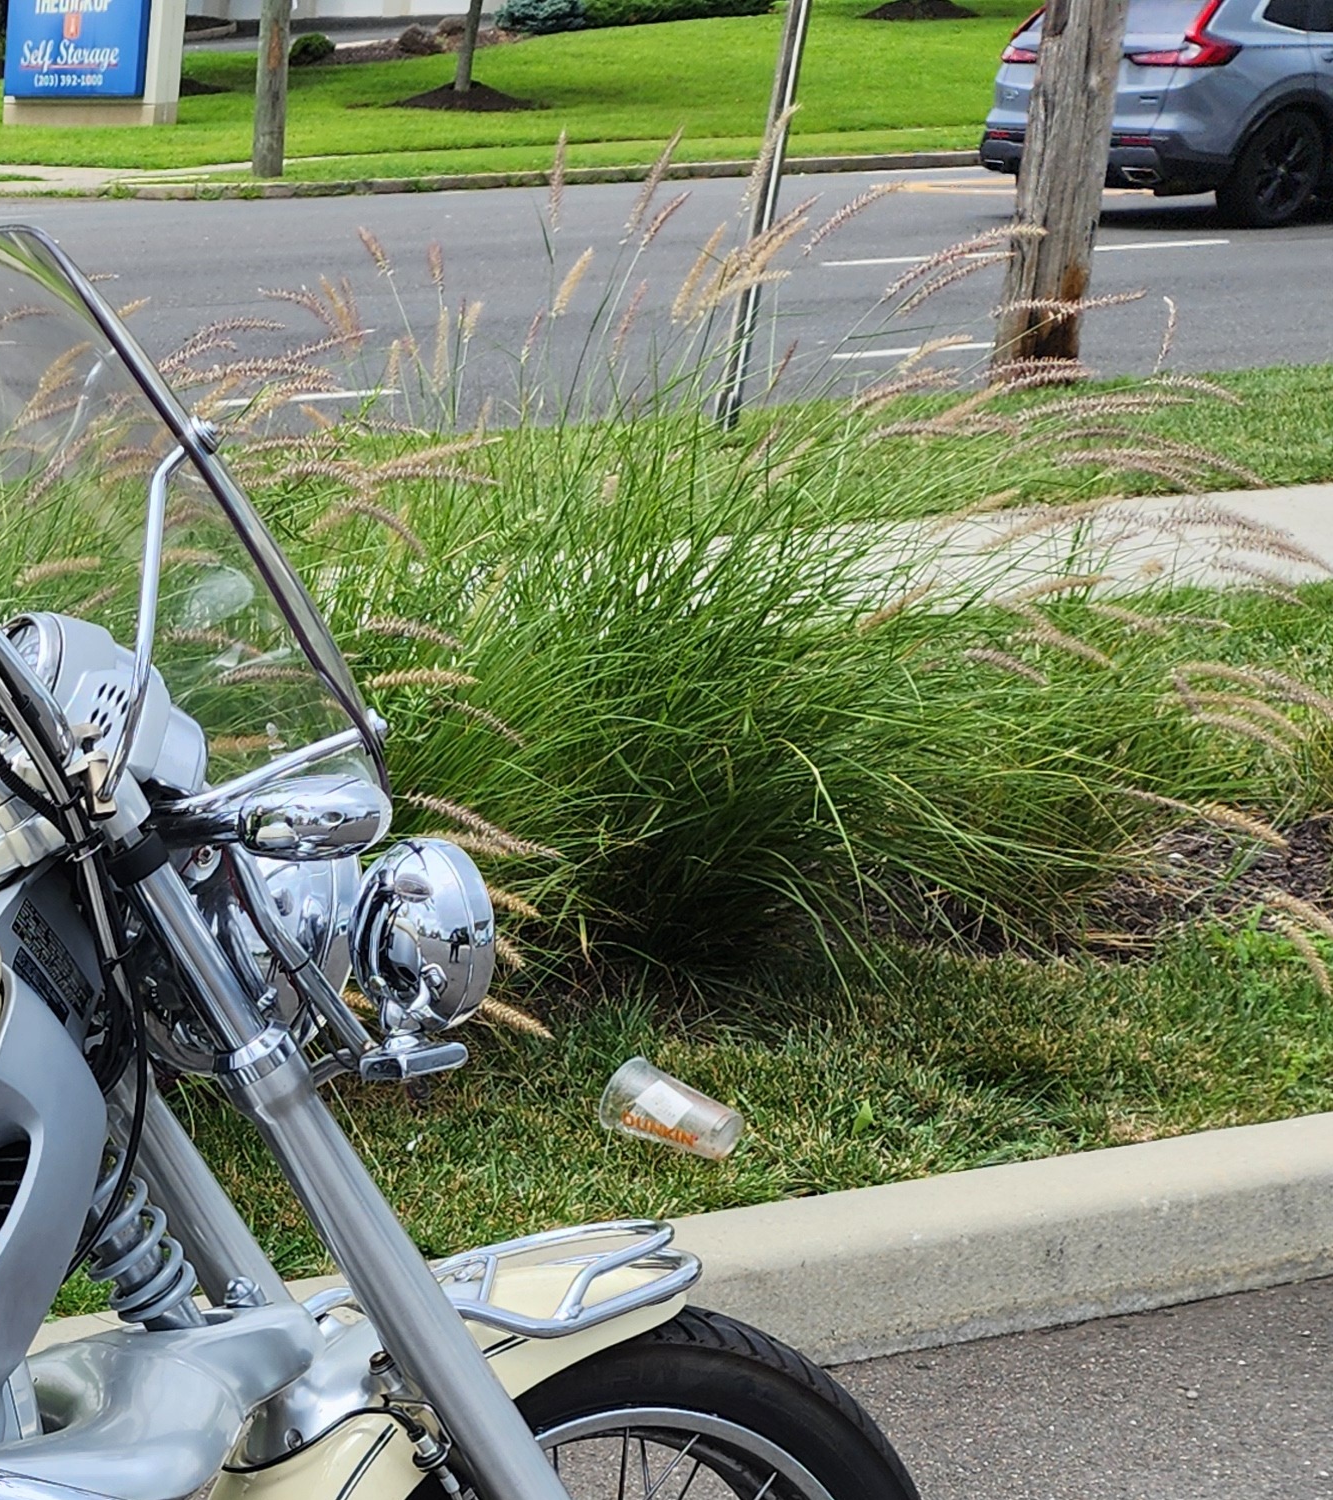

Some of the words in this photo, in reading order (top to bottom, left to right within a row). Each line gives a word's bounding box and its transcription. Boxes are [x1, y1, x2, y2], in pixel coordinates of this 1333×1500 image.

[21, 40, 53, 73] Self
[58, 40, 119, 72] Storage
[34, 73, 59, 88] (203)
